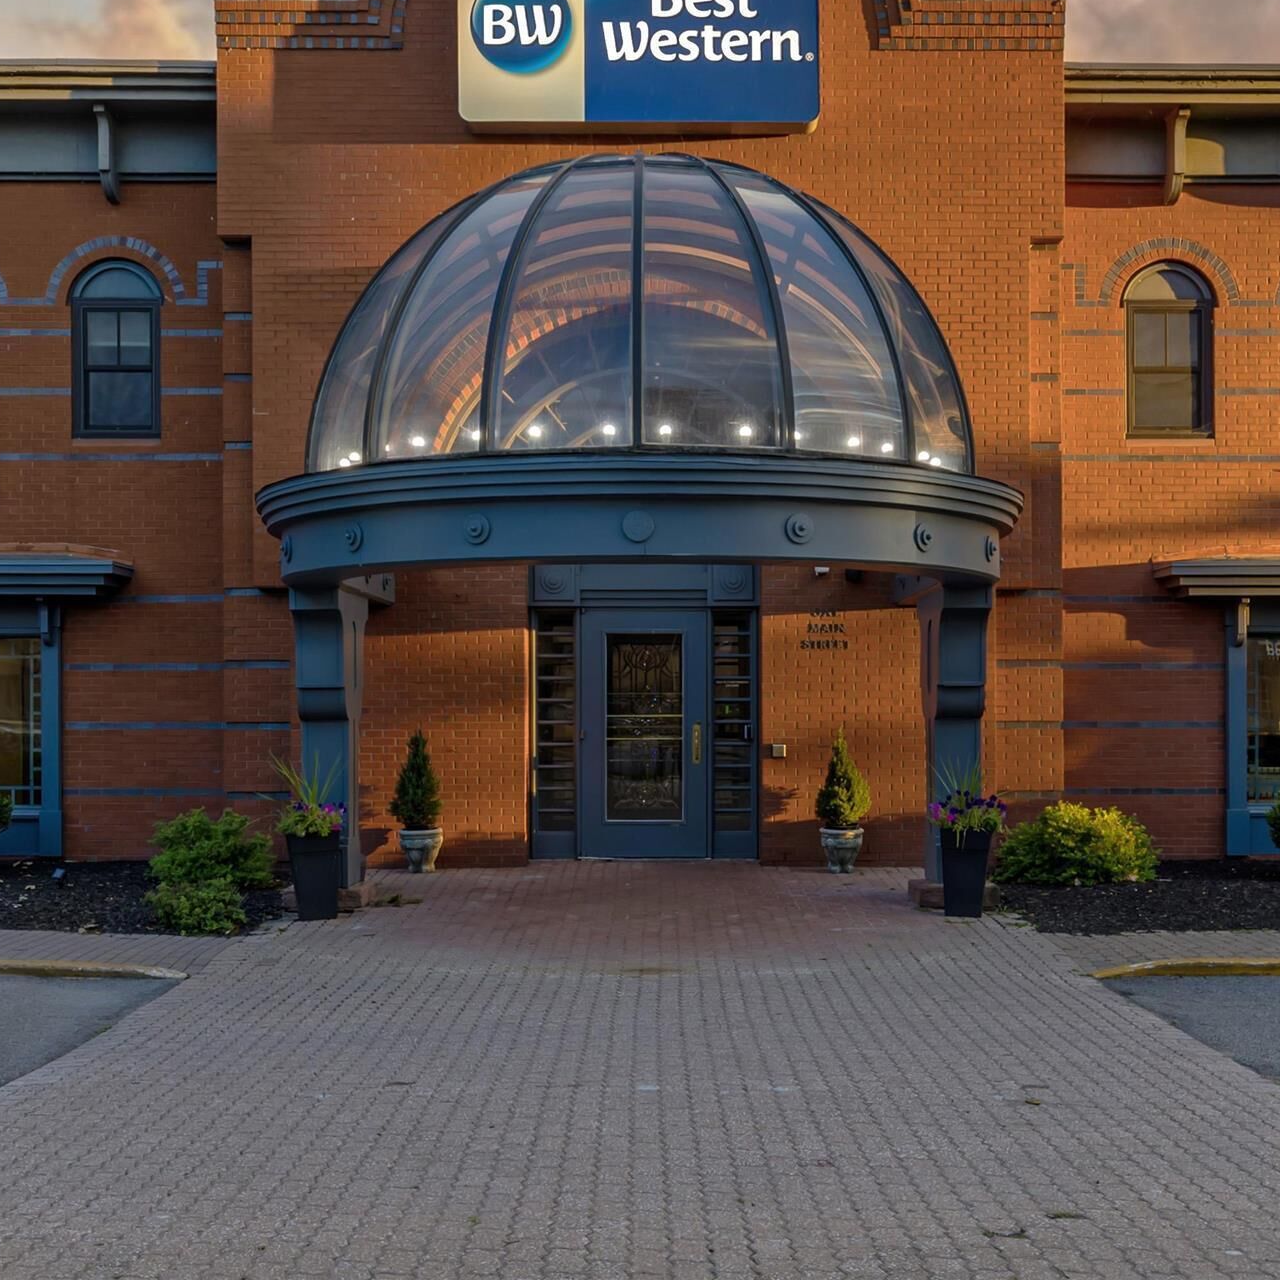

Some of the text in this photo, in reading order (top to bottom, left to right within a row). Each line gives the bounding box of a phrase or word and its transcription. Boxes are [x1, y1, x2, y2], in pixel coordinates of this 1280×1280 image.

[483, 4, 562, 45] BW
[602, 21, 803, 61] Western
[807, 624, 847, 633] MAIN
[800, 640, 848, 650] STREET
